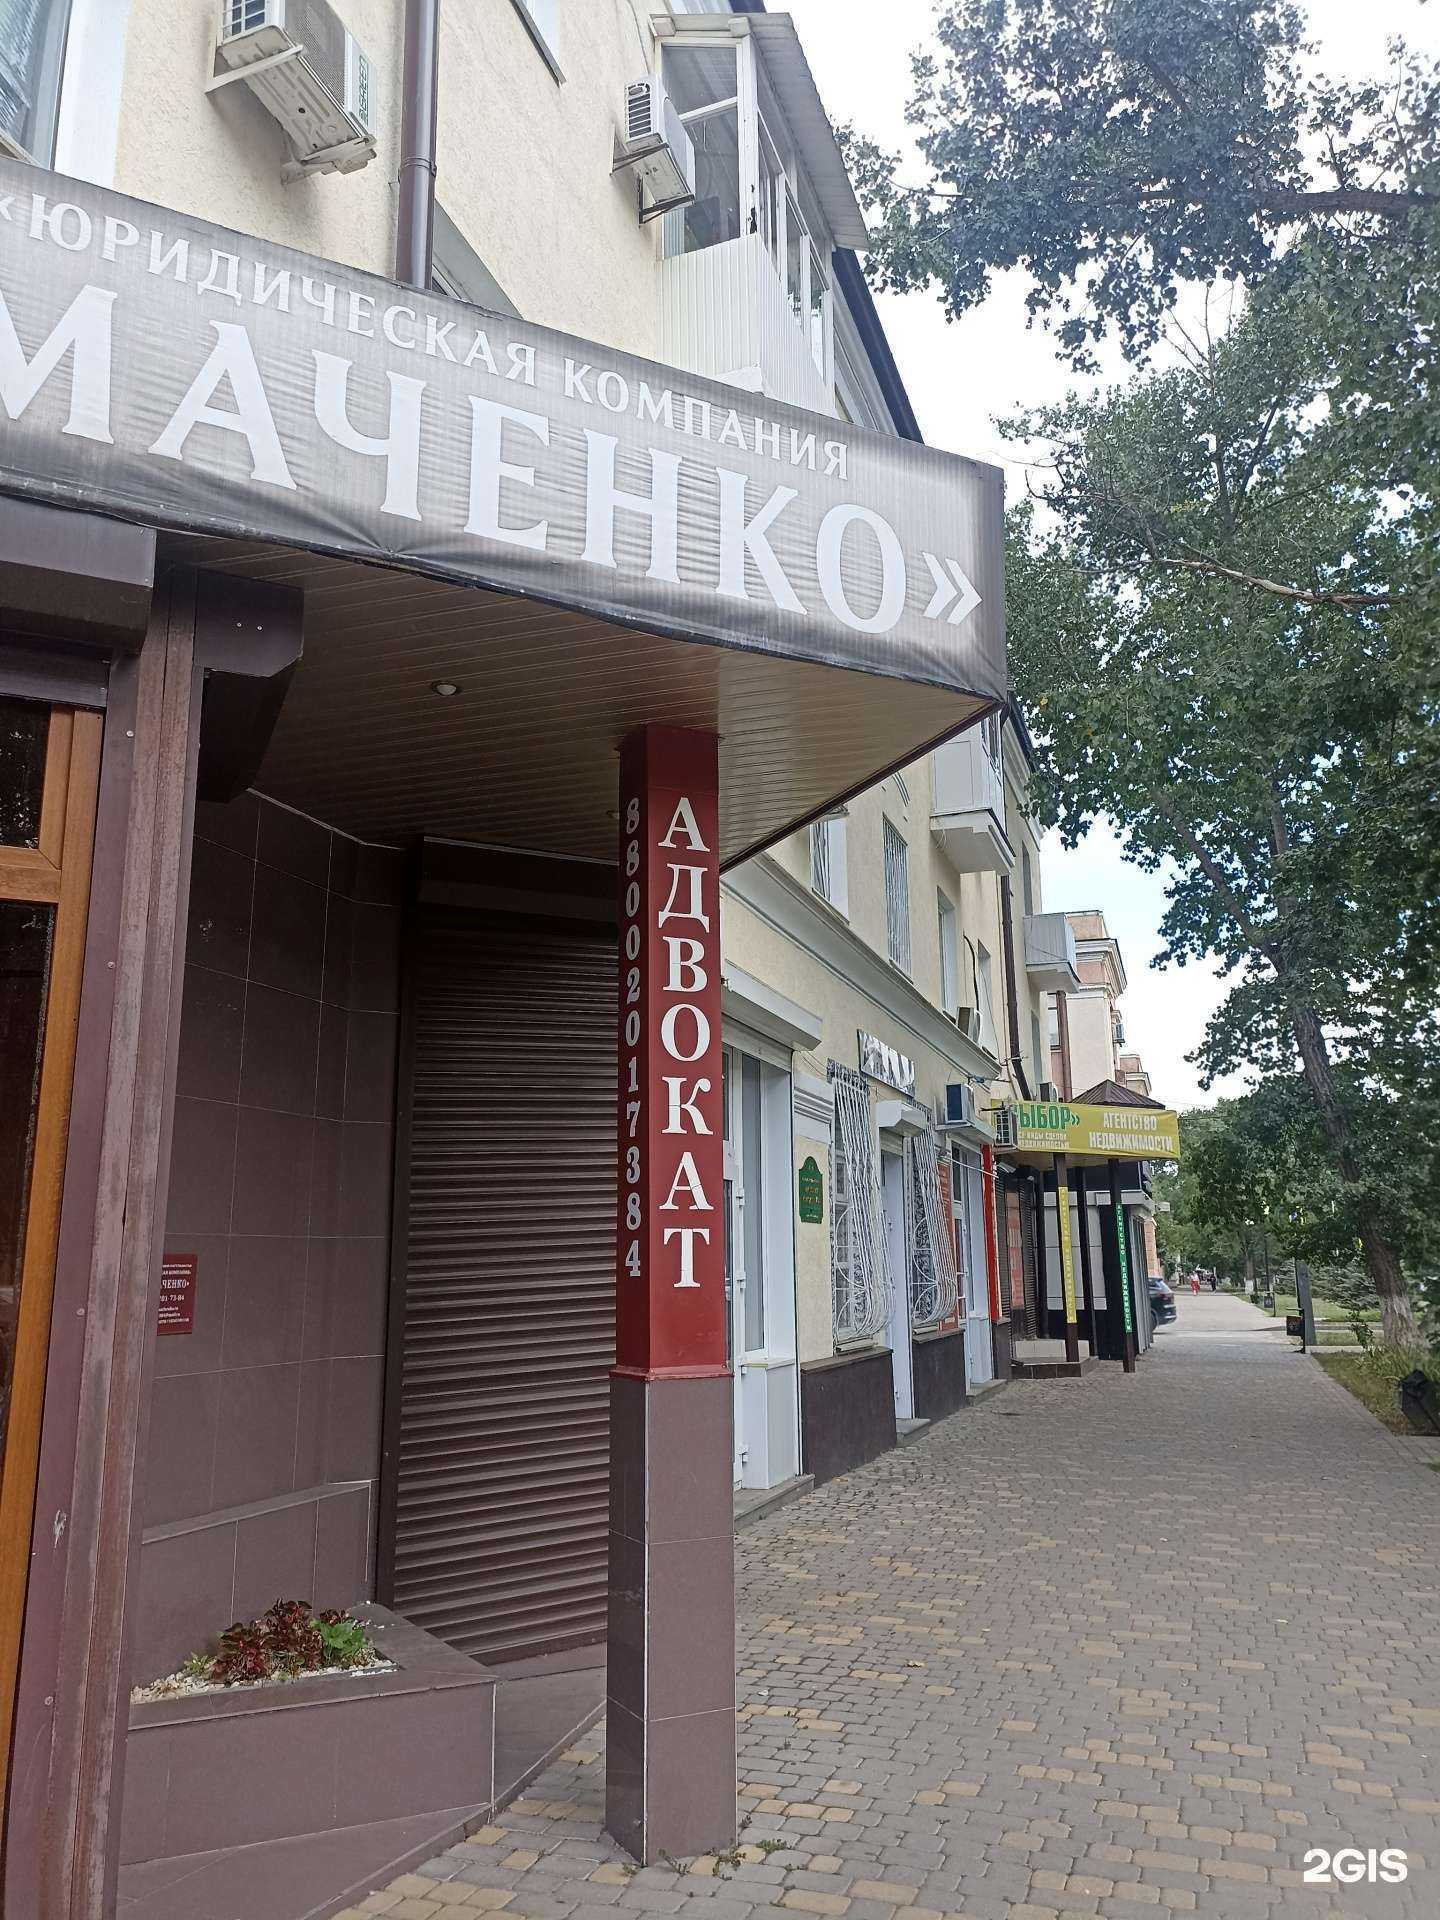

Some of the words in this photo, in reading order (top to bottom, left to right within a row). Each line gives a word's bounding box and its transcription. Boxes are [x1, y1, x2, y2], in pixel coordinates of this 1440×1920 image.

[563, 358, 849, 480] КОМПАНИЯ
[625, 797, 641, 1277] 88002017384
[657, 797, 714, 1287] АДВОКАТ
[1015, 1103, 1080, 1130] ЫБОР»
[1088, 1131, 1173, 1152] НЕДВИЖИМОСТИ
[1103, 1111, 1157, 1131] АГЕНТСТВО
